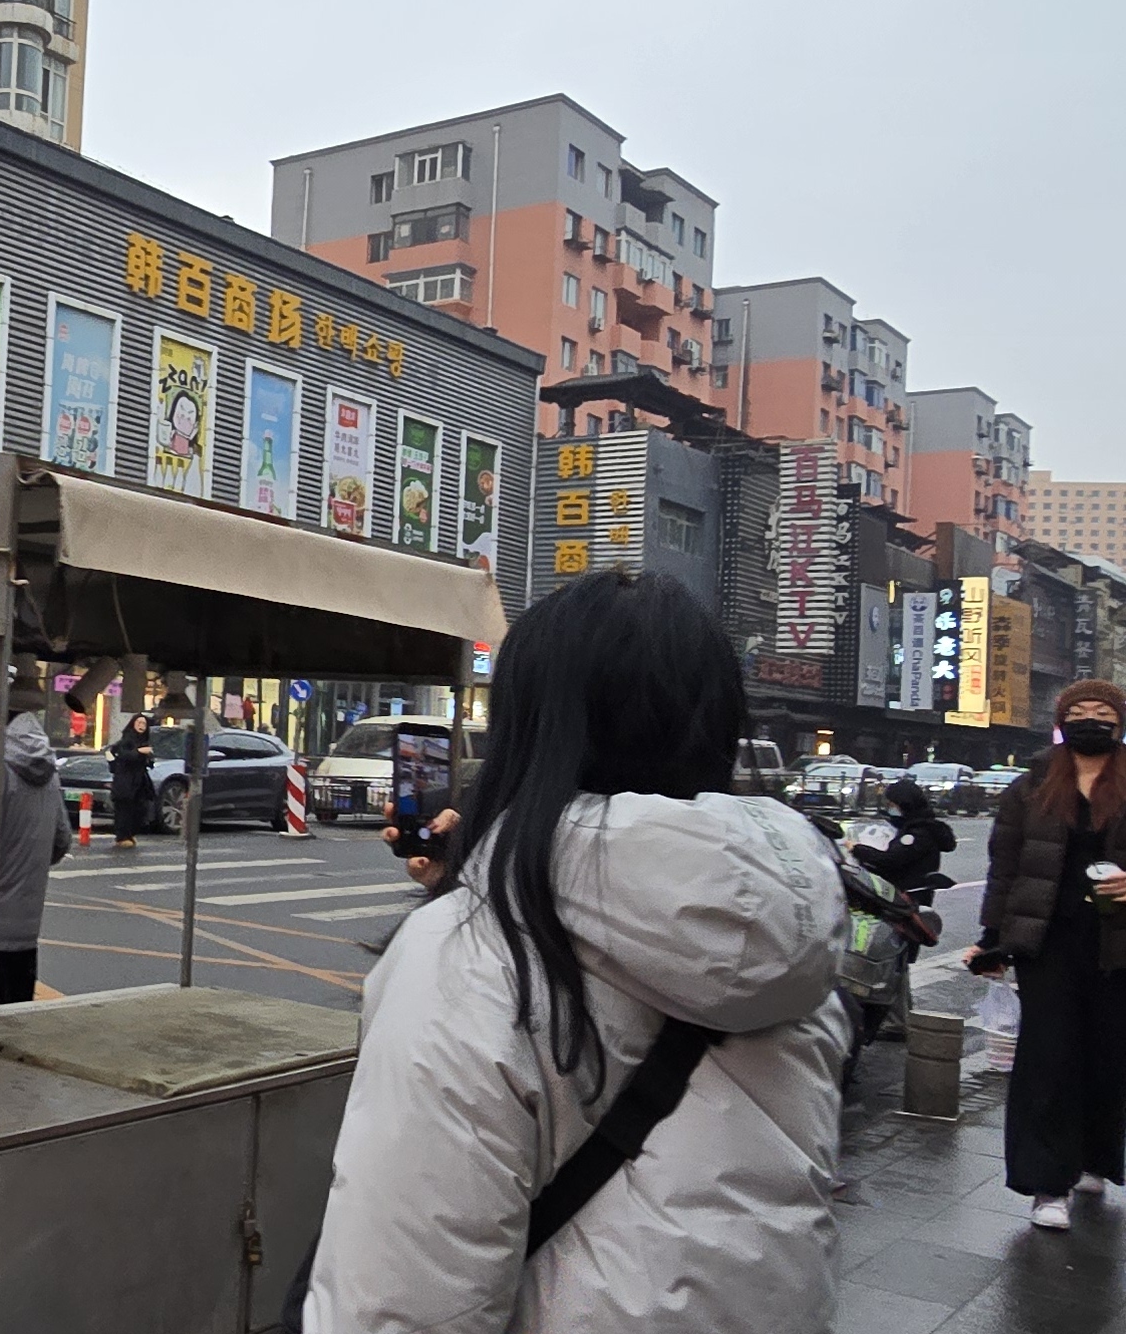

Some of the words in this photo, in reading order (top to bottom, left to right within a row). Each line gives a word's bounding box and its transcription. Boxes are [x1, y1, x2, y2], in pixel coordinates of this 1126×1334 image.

[126, 231, 303, 350] 韩百商场
[315, 313, 407, 378] 한백쇼핑
[909, 649, 923, 707] ChaPanda
